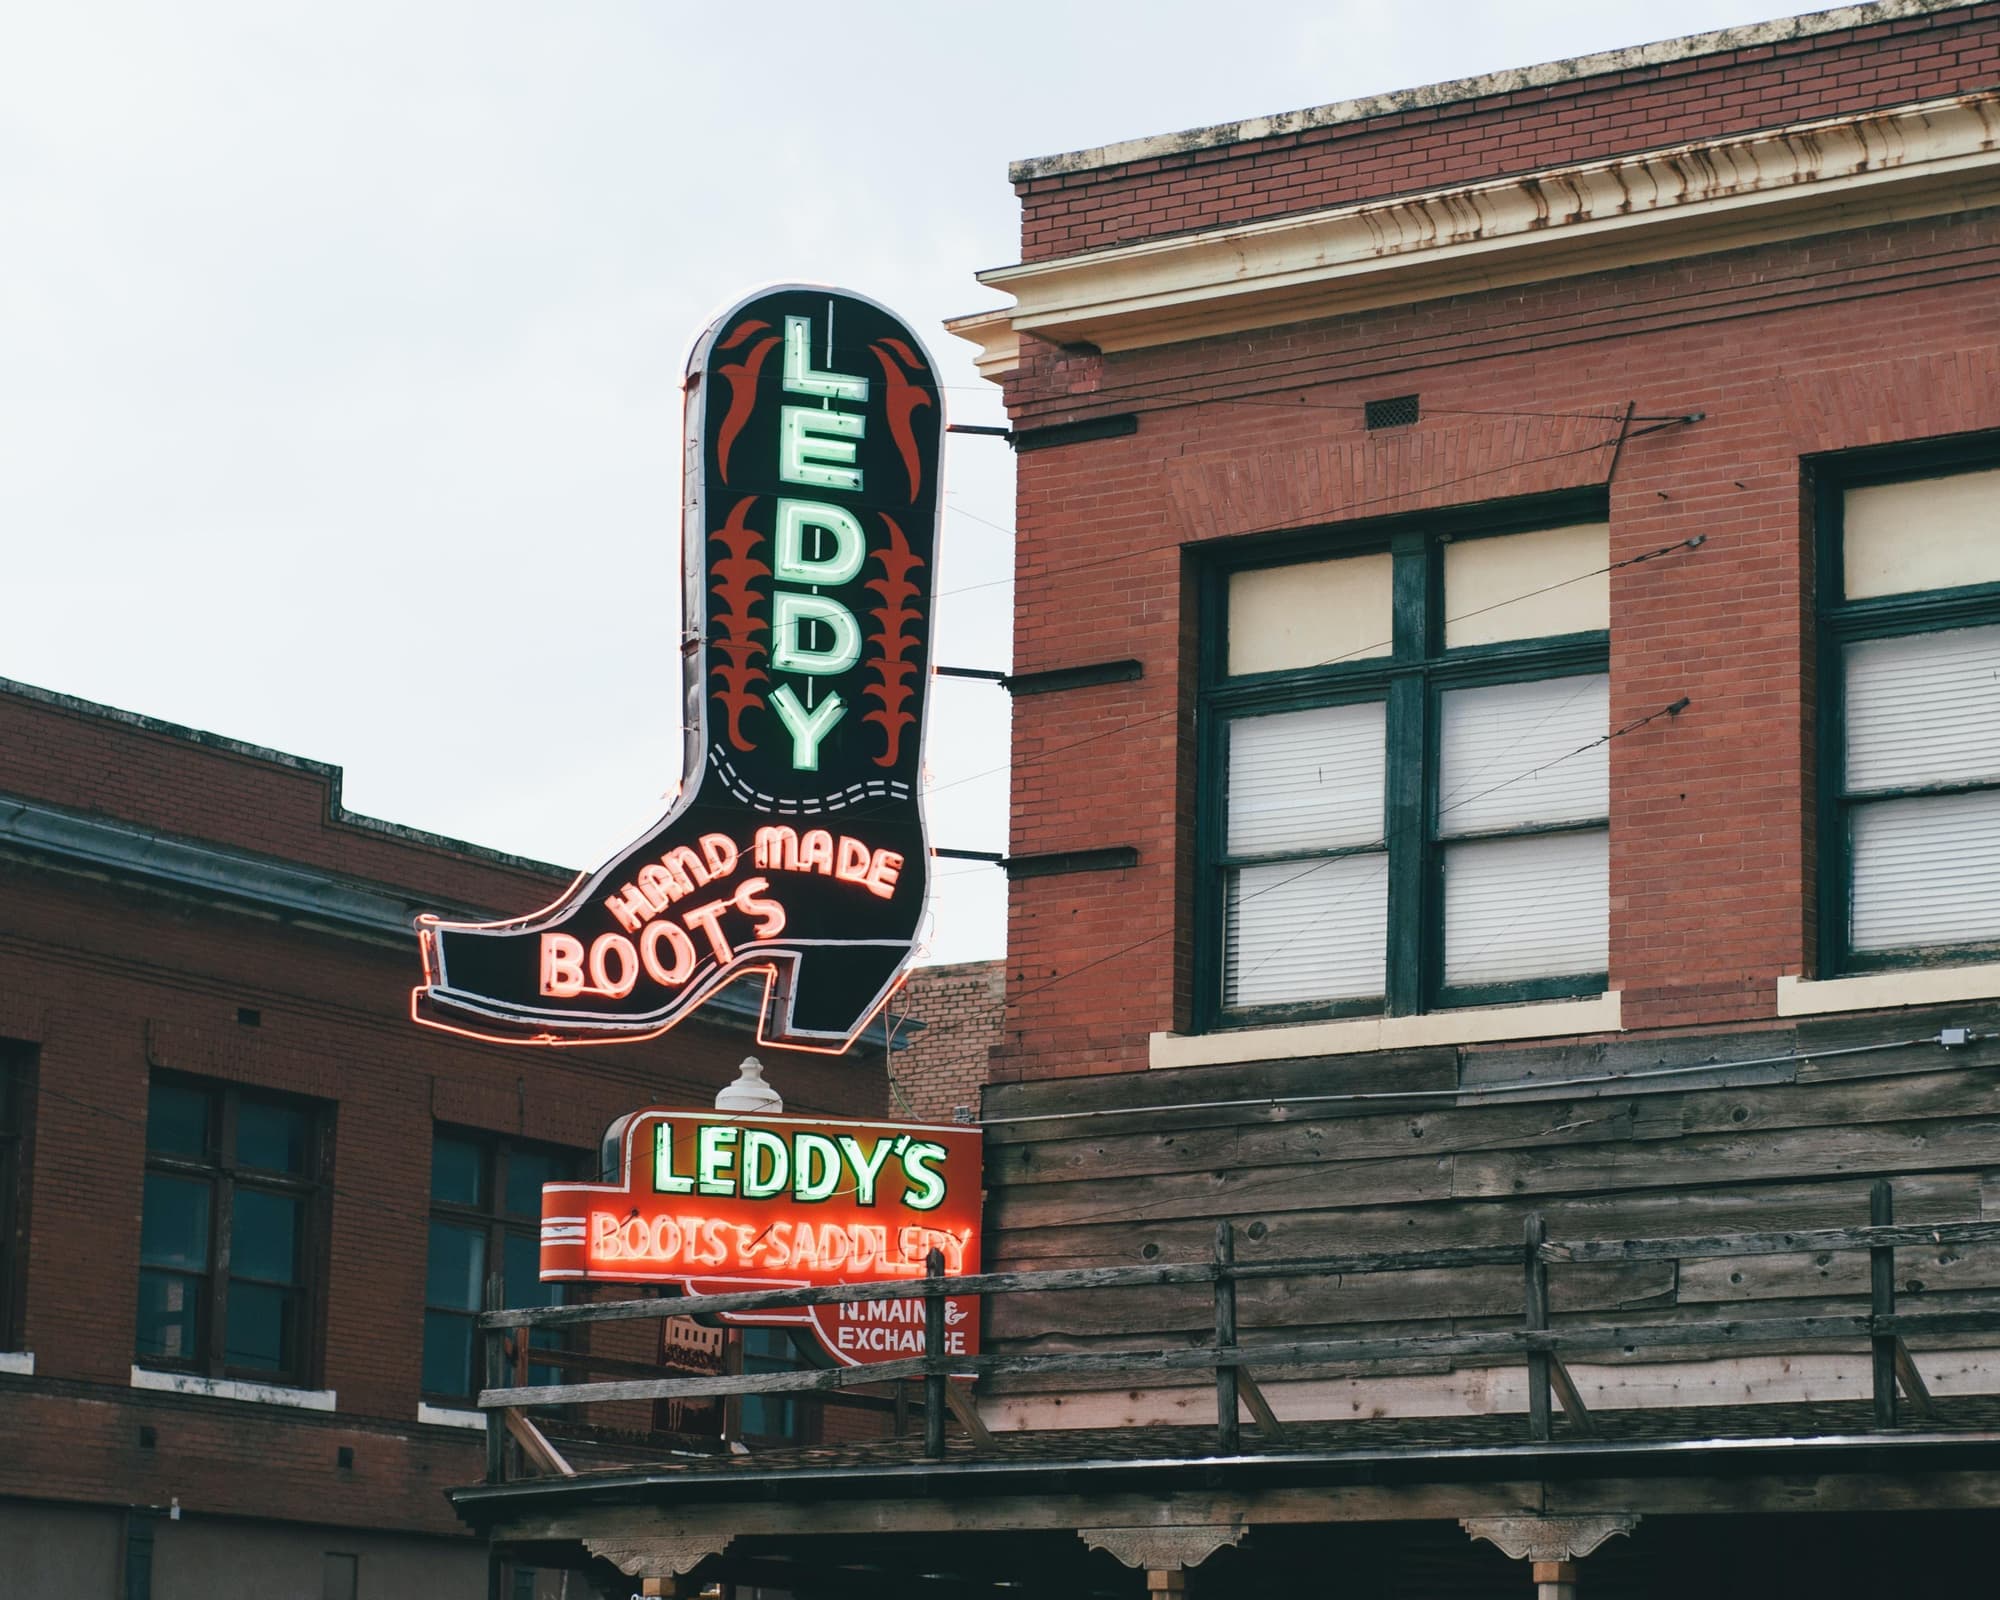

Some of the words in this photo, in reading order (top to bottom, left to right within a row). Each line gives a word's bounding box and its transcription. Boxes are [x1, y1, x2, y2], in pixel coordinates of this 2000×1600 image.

[768, 315, 869, 771] LEDDY
[604, 833, 738, 933] HAND
[754, 825, 905, 899] MADE
[539, 877, 786, 998] BOOTS
[653, 1122, 948, 1211] LEDDY'S
[590, 1211, 728, 1267] BOOTS
[736, 1224, 767, 1267] &
[944, 1301, 969, 1326] &
